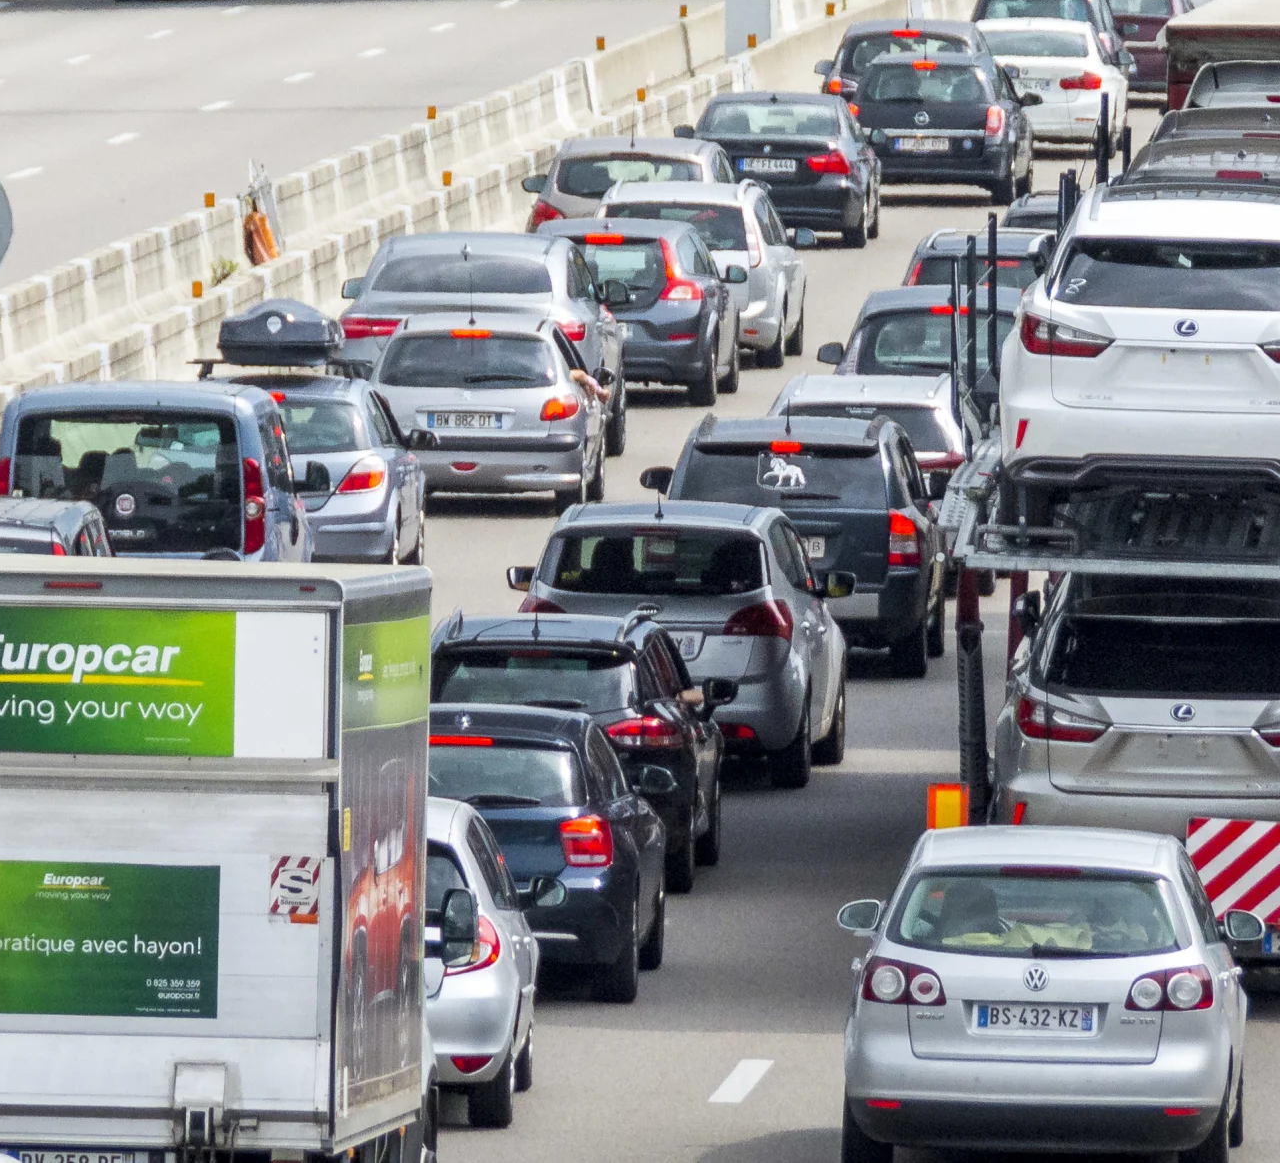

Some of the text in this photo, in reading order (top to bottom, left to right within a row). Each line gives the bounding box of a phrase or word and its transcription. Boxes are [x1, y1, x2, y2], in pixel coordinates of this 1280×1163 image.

[65, 699, 130, 723] your
[139, 701, 204, 726] way
[43, 873, 105, 887] Europcar
[35, 891, 112, 902] moving your way
[81, 937, 129, 954] avec
[133, 934, 202, 959] hayon!
[153, 979, 168, 987] 825
[169, 979, 184, 987] 359
[186, 980, 201, 988] 359
